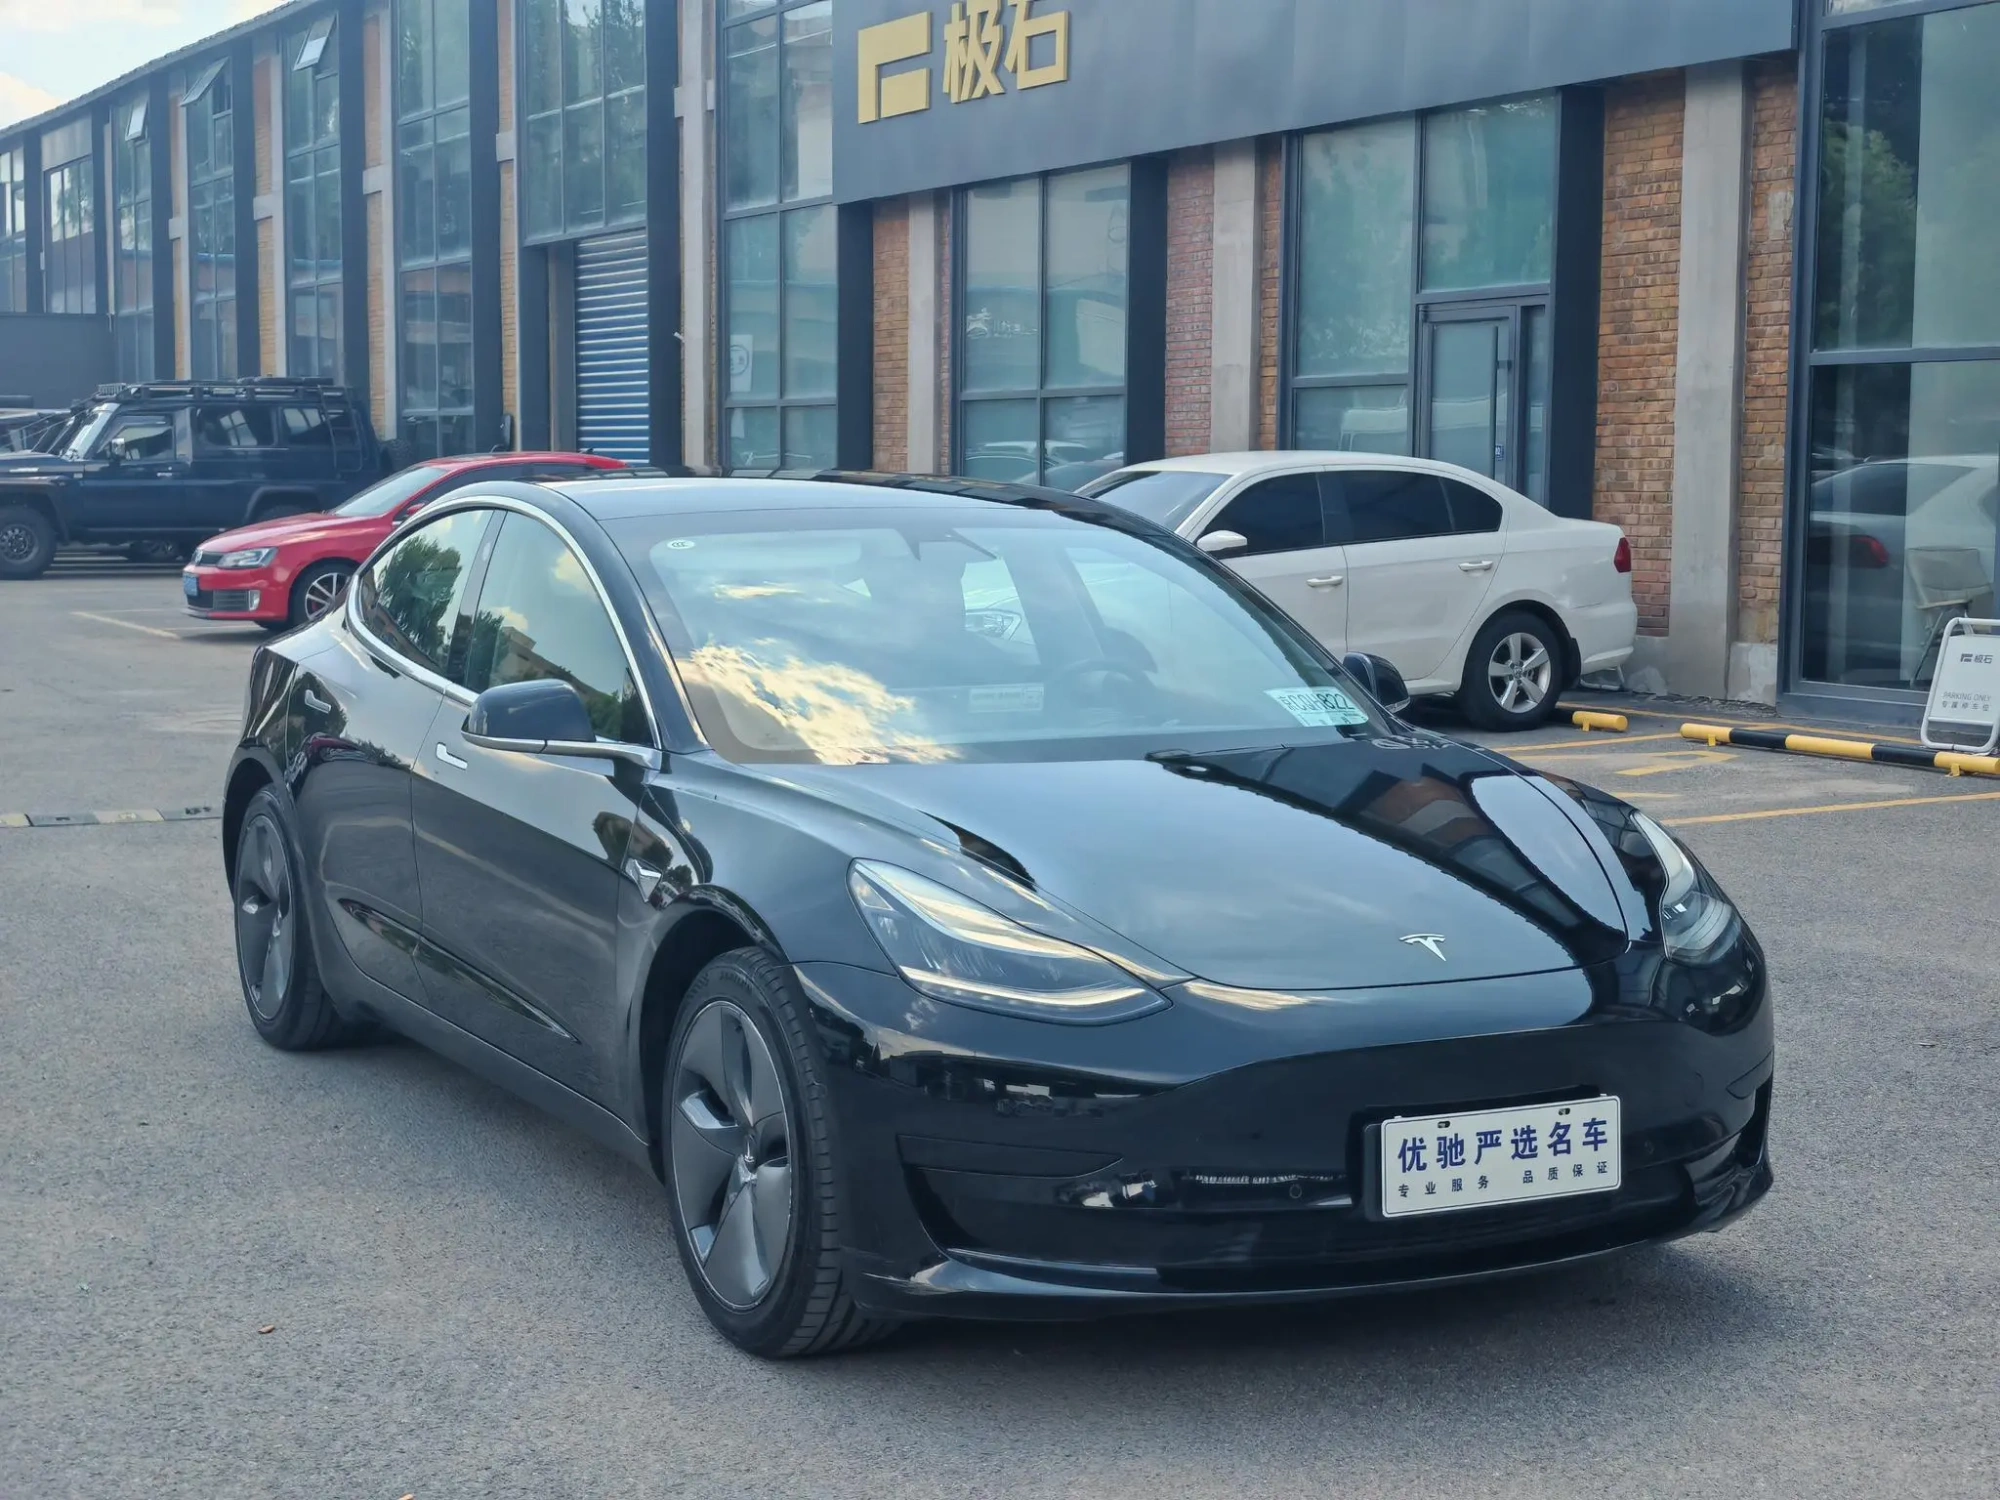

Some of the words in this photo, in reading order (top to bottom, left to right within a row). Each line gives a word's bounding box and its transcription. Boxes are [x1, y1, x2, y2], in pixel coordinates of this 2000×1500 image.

[943, 0, 1069, 104] 极石
[1973, 653, 1993, 665] 极石
[1942, 691, 1972, 701] PARKING
[1973, 693, 1992, 702] ONLY
[1397, 1117, 1608, 1174] 优驰严选名车
[1397, 1174, 1489, 1198] 专业服务
[1522, 1161, 1608, 1184] 品质保证
